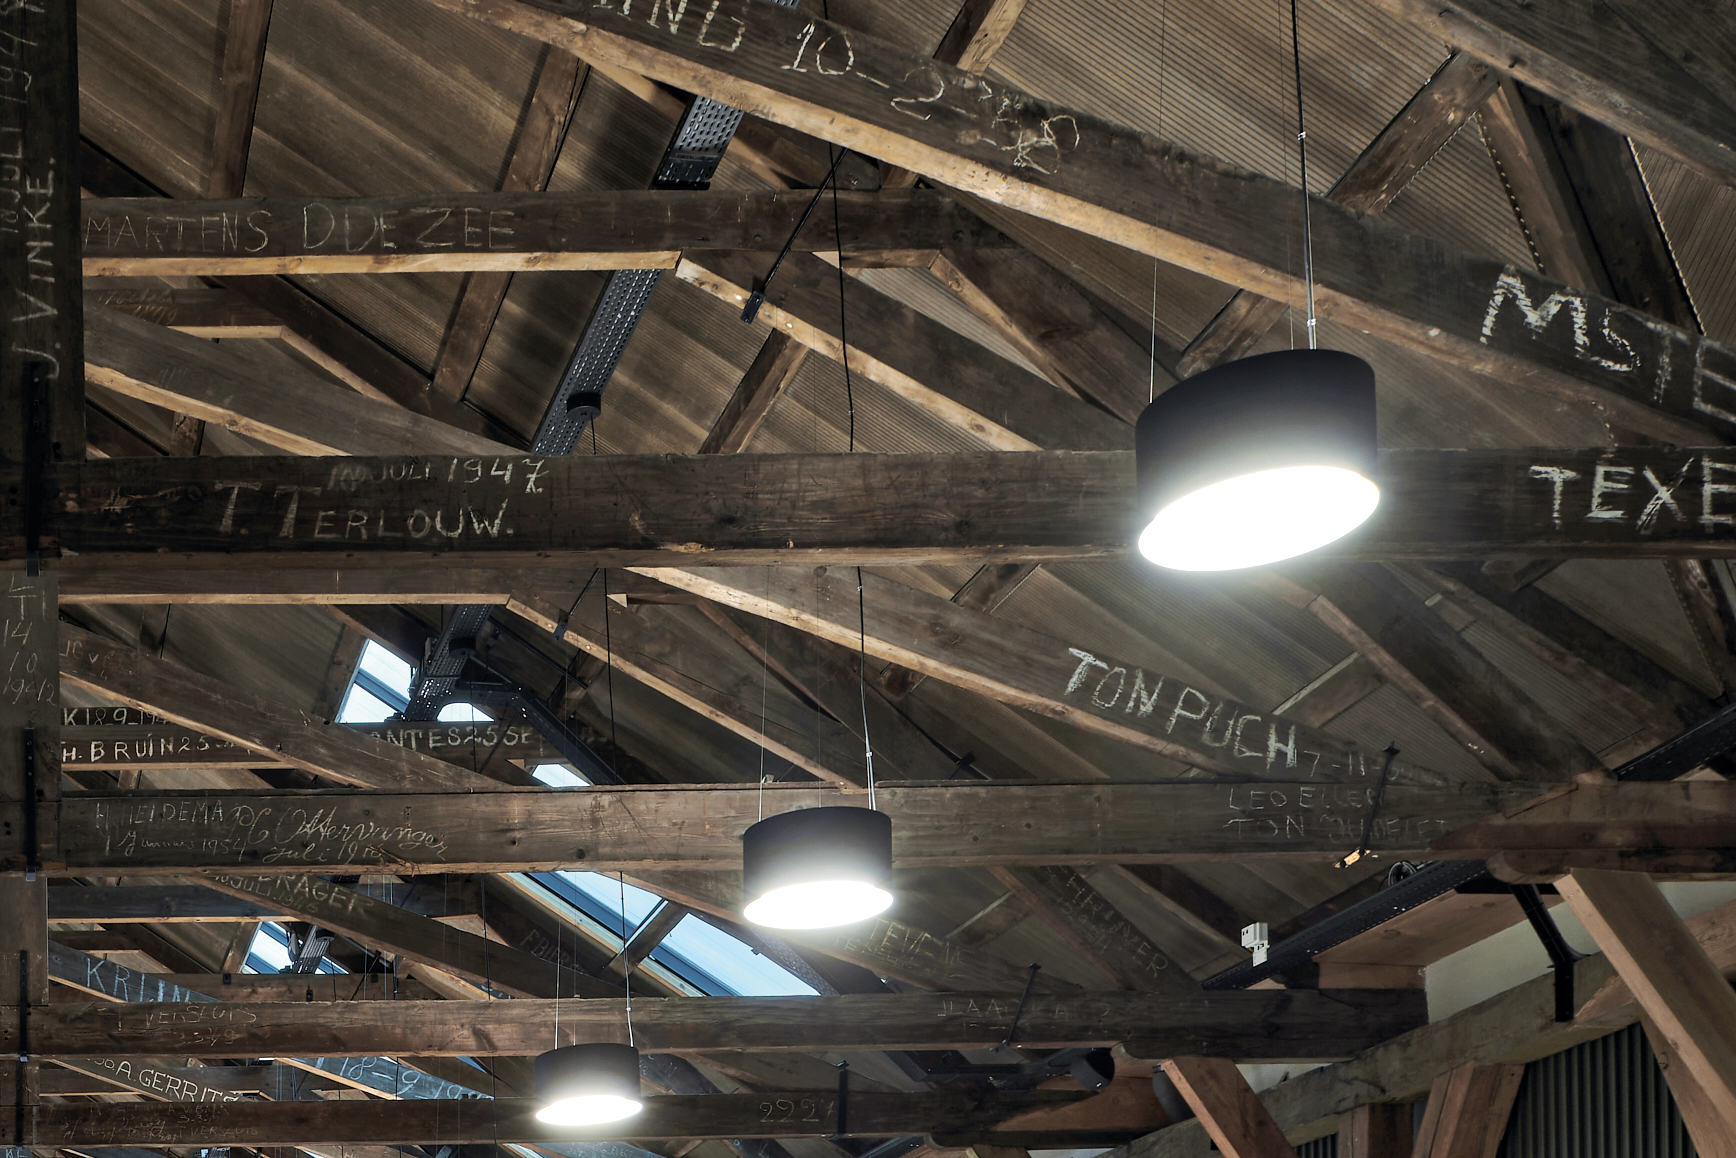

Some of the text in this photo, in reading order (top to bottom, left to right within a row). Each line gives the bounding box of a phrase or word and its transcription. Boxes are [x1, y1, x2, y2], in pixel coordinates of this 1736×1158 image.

[11, 156, 59, 323] VINKE.
[84, 209, 272, 253] MARTENS
[370, 459, 432, 484] JULI
[1528, 451, 1736, 536] TEXE
[2, 618, 33, 647] 14
[1064, 647, 1164, 719] TON
[1166, 686, 1299, 774] PUCH
[370, 727, 462, 751] NTES
[1229, 787, 1288, 811] LEO
[202, 837, 247, 863] 1954
